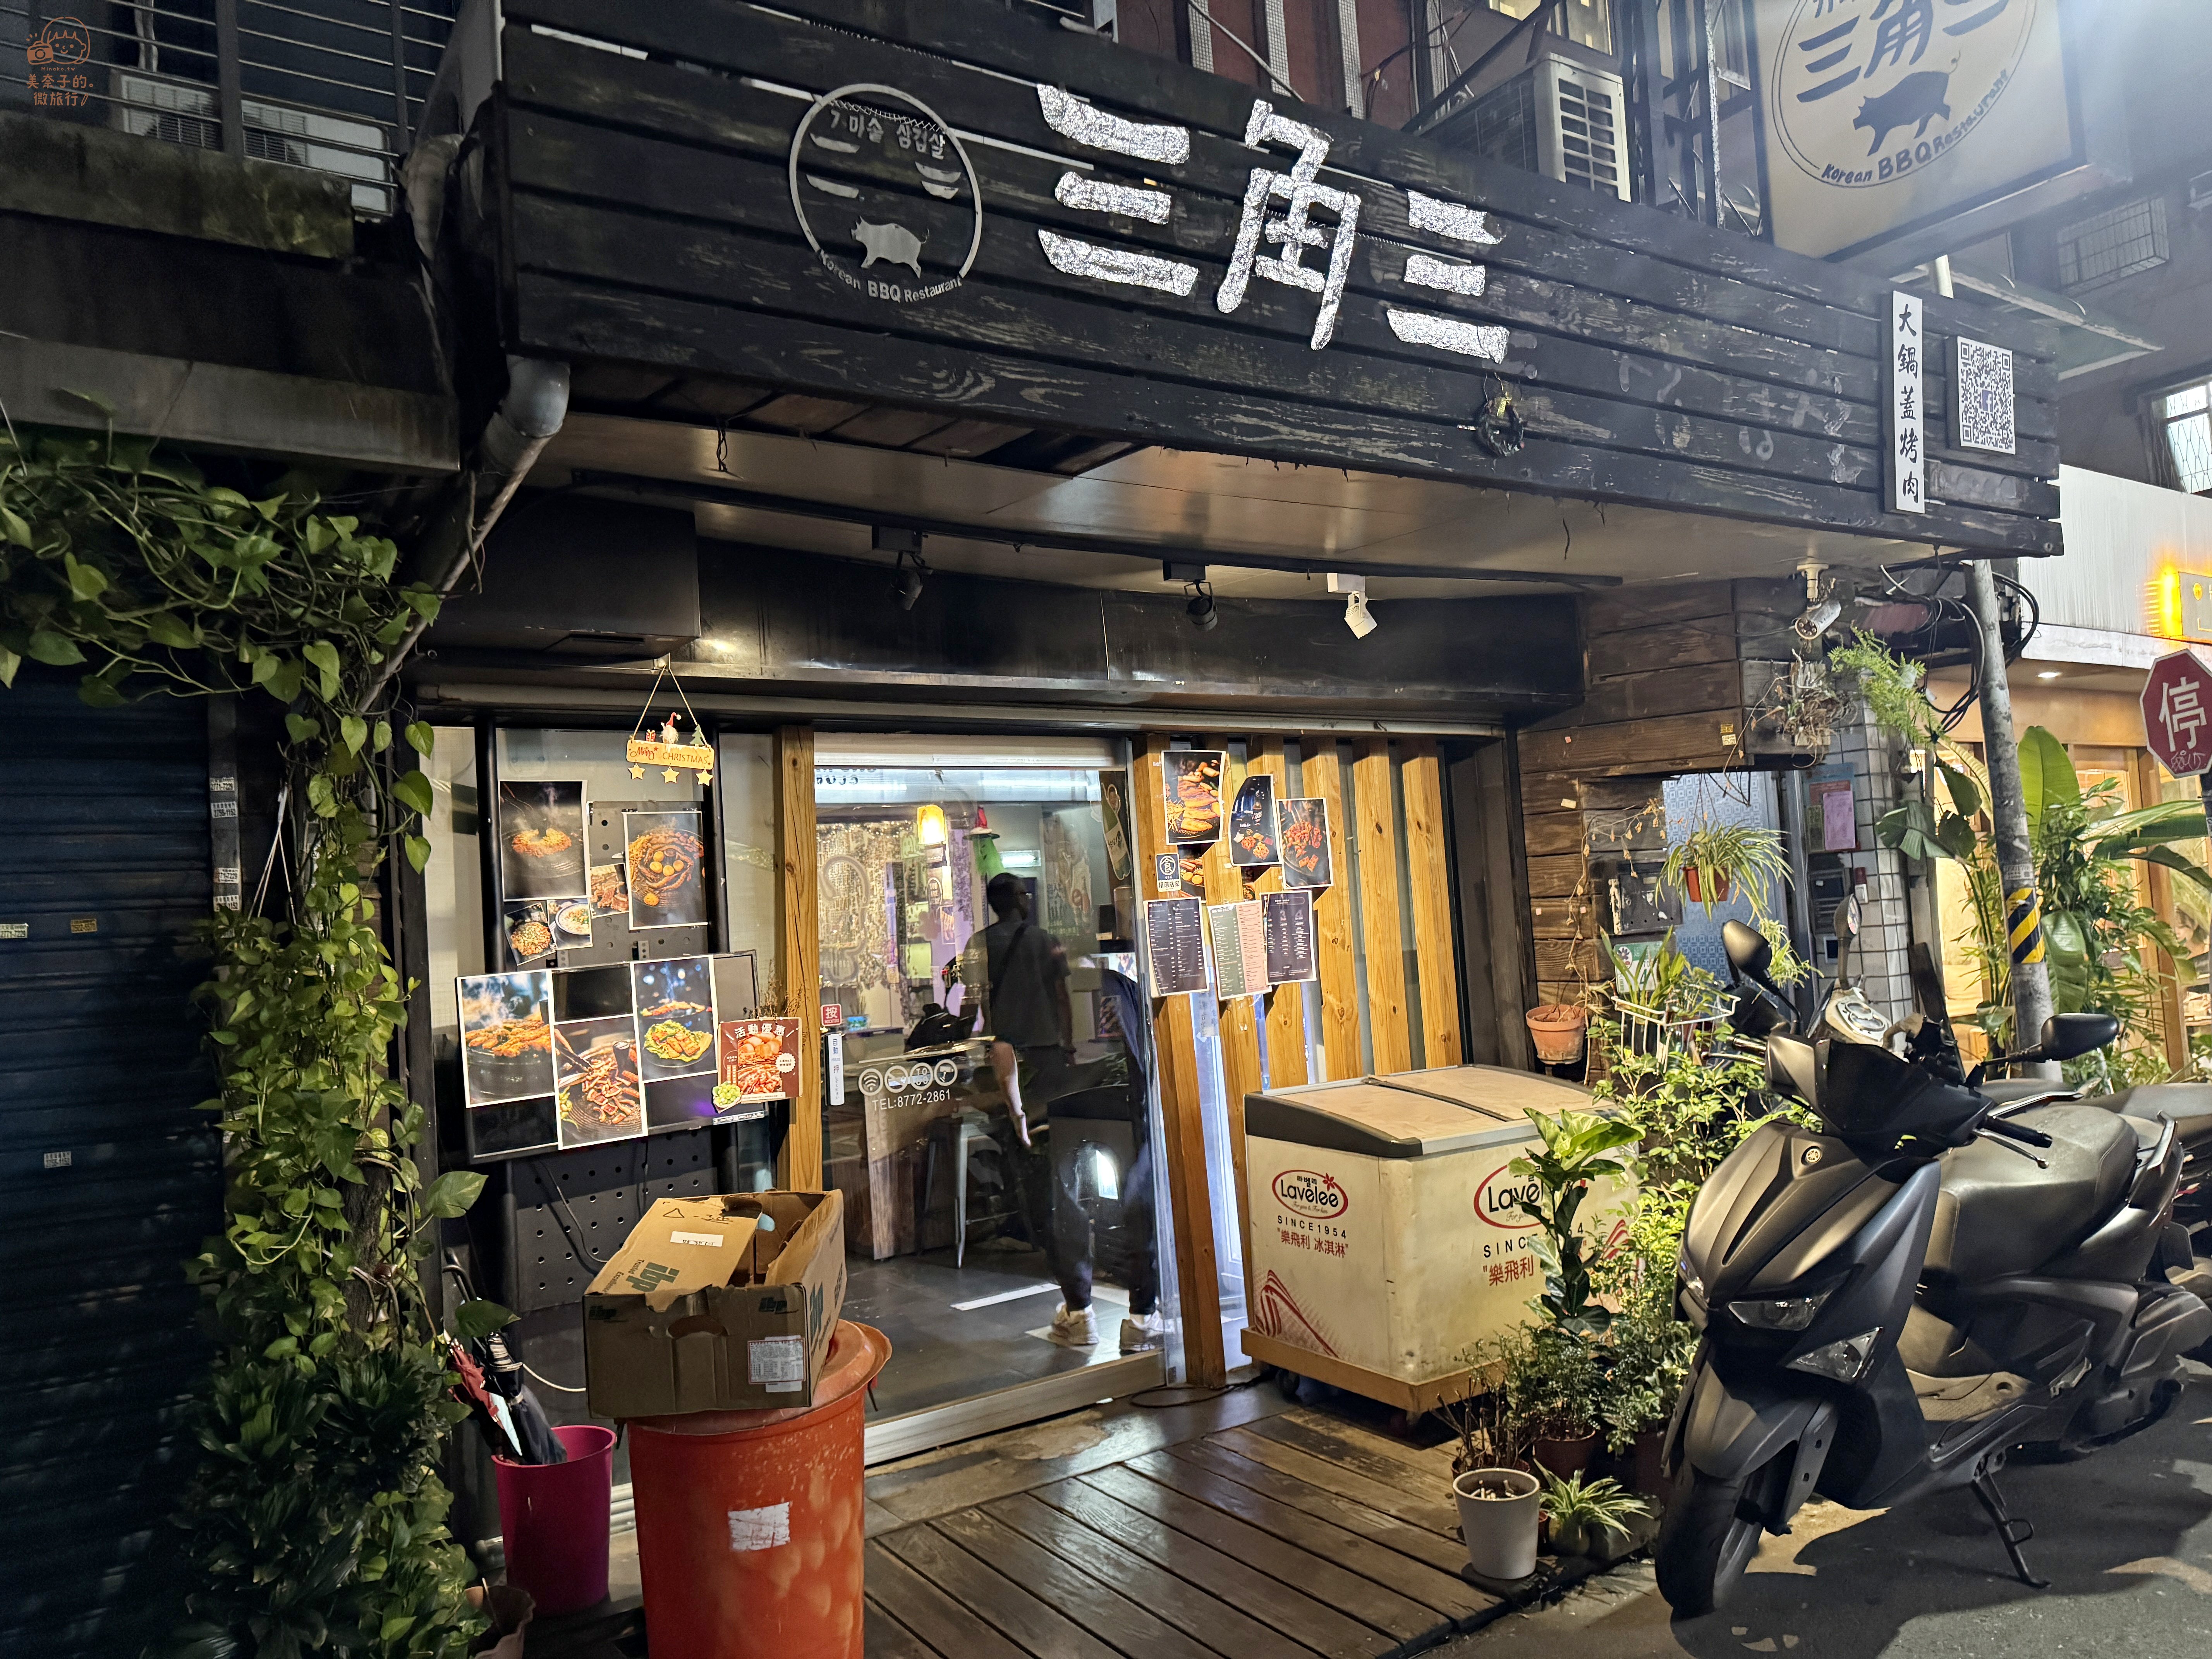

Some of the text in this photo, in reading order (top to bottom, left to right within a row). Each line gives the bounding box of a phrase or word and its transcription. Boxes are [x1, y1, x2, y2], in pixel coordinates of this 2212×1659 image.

[1821, 69, 2008, 183] Korean BBQ Restaurant
[1037, 84, 1510, 364] 三角三
[819, 248, 962, 303] Korean BBQ Restaurant
[1898, 304, 1918, 503] 大鍋蓋烤肉
[2159, 676, 2207, 752] 停
[663, 752, 708, 764] CHRISTMAS
[825, 1006, 838, 1019] 按
[734, 1023, 786, 1039] 活動優惠
[872, 1089, 950, 1111] TEL:8772-2861
[1281, 1179, 1338, 1207] Lavelee
[1488, 1179, 1543, 1213] Lavel
[1484, 1233, 1538, 1258] SINC
